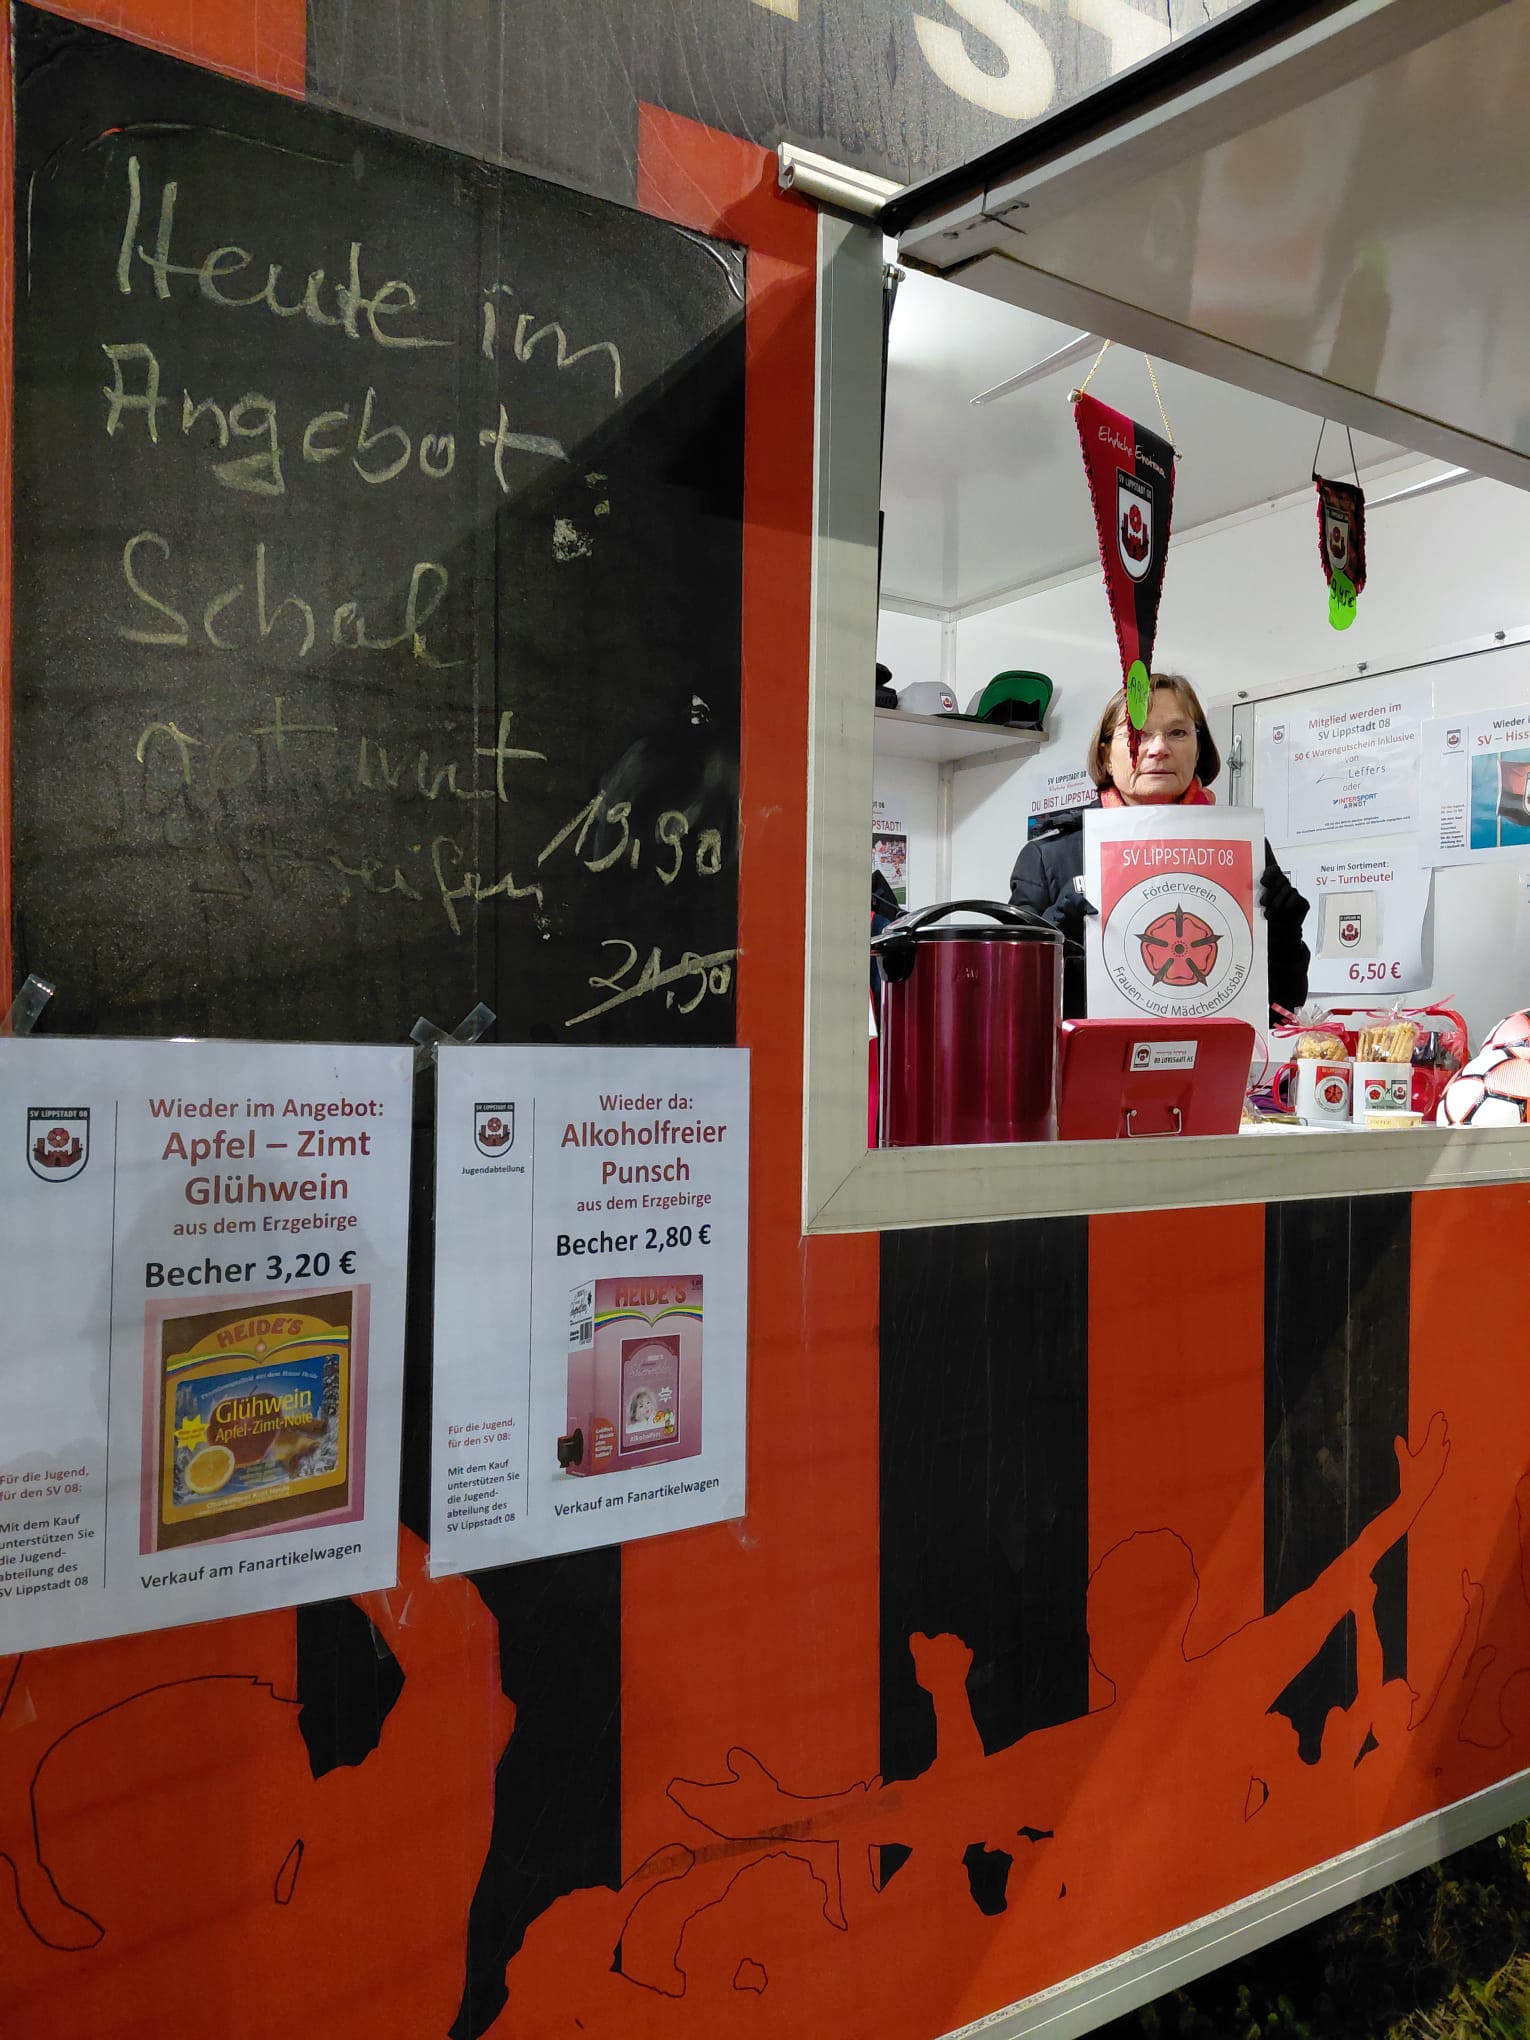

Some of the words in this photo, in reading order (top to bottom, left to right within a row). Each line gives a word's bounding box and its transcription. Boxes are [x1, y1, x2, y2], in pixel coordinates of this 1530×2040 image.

[118, 155, 456, 347] Heute
[483, 285, 624, 398] im
[102, 342, 570, 495] Angebot
[118, 530, 468, 668] Schal
[1309, 712, 1347, 728] Mitglied
[1350, 706, 1386, 720] werden
[1389, 703, 1401, 713] im
[1493, 717, 1525, 728] Wieder
[1318, 731, 1329, 741] SV
[1332, 721, 1376, 738] Lippstadt
[1379, 718, 1391, 728] 08
[1294, 752, 1303, 761] 50
[1312, 739, 1375, 758] Warengutschein
[1478, 734, 1492, 746] SV
[1056, 772, 1080, 784] LIPPSTADT
[1348, 765, 1386, 778] Leffers
[1342, 782, 1360, 792] oder
[1032, 800, 1041, 812] DU
[1044, 796, 1059, 809] BIST
[1061, 788, 1098, 806] LIPPSTAD
[1338, 792, 1378, 804] INTERSPORT
[1123, 849, 1140, 866] SV
[1144, 847, 1215, 866] LIPPSTADT
[1218, 849, 1234, 866] 08
[1336, 863, 1345, 872] im
[1347, 861, 1389, 871] Sortiment:
[1316, 876, 1328, 885] SV
[1338, 871, 1394, 885] Turnbeutel
[1142, 881, 1217, 903] Förderverein
[1349, 962, 1386, 983] 6,50
[1391, 962, 1401, 979] €
[1113, 966, 1144, 1001] Frauen-
[1146, 999, 1168, 1015] und
[1171, 965, 1246, 1016] Mädchenfussball
[149, 1099, 239, 1119] Wieder
[247, 1099, 275, 1117] im
[282, 1098, 384, 1121] Angebot:
[600, 1094, 662, 1111] Wieder
[667, 1093, 693, 1110] da:
[30, 1110, 39, 1118] SV
[41, 1110, 77, 1118] LIPPSTADT
[561, 1120, 727, 1148] Alkoholfreier
[162, 1129, 255, 1166] Apfel
[297, 1129, 371, 1157] Zimt
[462, 1164, 525, 1176] Jugendabteilung
[602, 1157, 690, 1185] Punsch
[185, 1173, 347, 1205] Glühwein
[577, 1200, 602, 1212] aus
[606, 1196, 638, 1210] dem
[642, 1192, 712, 1210] Erzgebirge
[173, 1221, 207, 1236] aus
[214, 1217, 256, 1235] dem
[263, 1213, 357, 1234] Erzgebirge
[557, 1231, 638, 1256] Becher
[645, 1226, 692, 1255] 2,80
[698, 1224, 711, 1245] €
[145, 1258, 257, 1288] Becher
[266, 1252, 330, 1285] 3,20
[339, 1250, 357, 1275] €
[217, 1317, 303, 1349] HEIDE'S
[215, 1388, 311, 1424] Glühwein
[215, 1411, 313, 1443] Apfel-Zimt-Note
[448, 1425, 463, 1435] Für
[466, 1422, 480, 1432] die
[481, 1418, 515, 1431] Jugend,
[448, 1438, 461, 1448] für
[464, 1436, 480, 1446] den
[483, 1434, 495, 1444] SV
[497, 1432, 511, 1442] 08:
[0, 1475, 19, 1485] Für
[23, 1471, 41, 1482] die
[44, 1466, 89, 1481] Jugend,
[448, 1467, 464, 1477] Mit
[466, 1463, 486, 1474] dem
[488, 1459, 509, 1470] Kauf
[447, 1475, 505, 1490] unterstützen
[506, 1472, 520, 1481] Sie
[21, 1487, 42, 1499] den
[46, 1486, 61, 1496] SV
[64, 1484, 82, 1493] 08:
[447, 1494, 461, 1505] die
[464, 1488, 499, 1502] Jugend-
[554, 1497, 603, 1516] Verkauf
[606, 1494, 624, 1507] am
[628, 1477, 719, 1503] Fanartikelwagen
[447, 1504, 489, 1519] abteilung
[492, 1502, 507, 1511] des
[0, 1523, 19, 1533] Mit
[24, 1520, 49, 1530] dem
[53, 1514, 80, 1526] Kauf
[447, 1523, 458, 1533] SV
[461, 1515, 503, 1531] Lippstadt
[505, 1512, 515, 1522] 08
[0, 1533, 74, 1550] unterstützen
[78, 1529, 94, 1539] Sie
[19, 1548, 66, 1563] Jugend-
[58, 1563, 78, 1574] des
[141, 1566, 205, 1589] Verkauf
[209, 1565, 233, 1578] am
[239, 1543, 362, 1574] Fanartikelwagen
[16, 1579, 71, 1596] Lippstadt
[74, 1576, 89, 1586] 08
